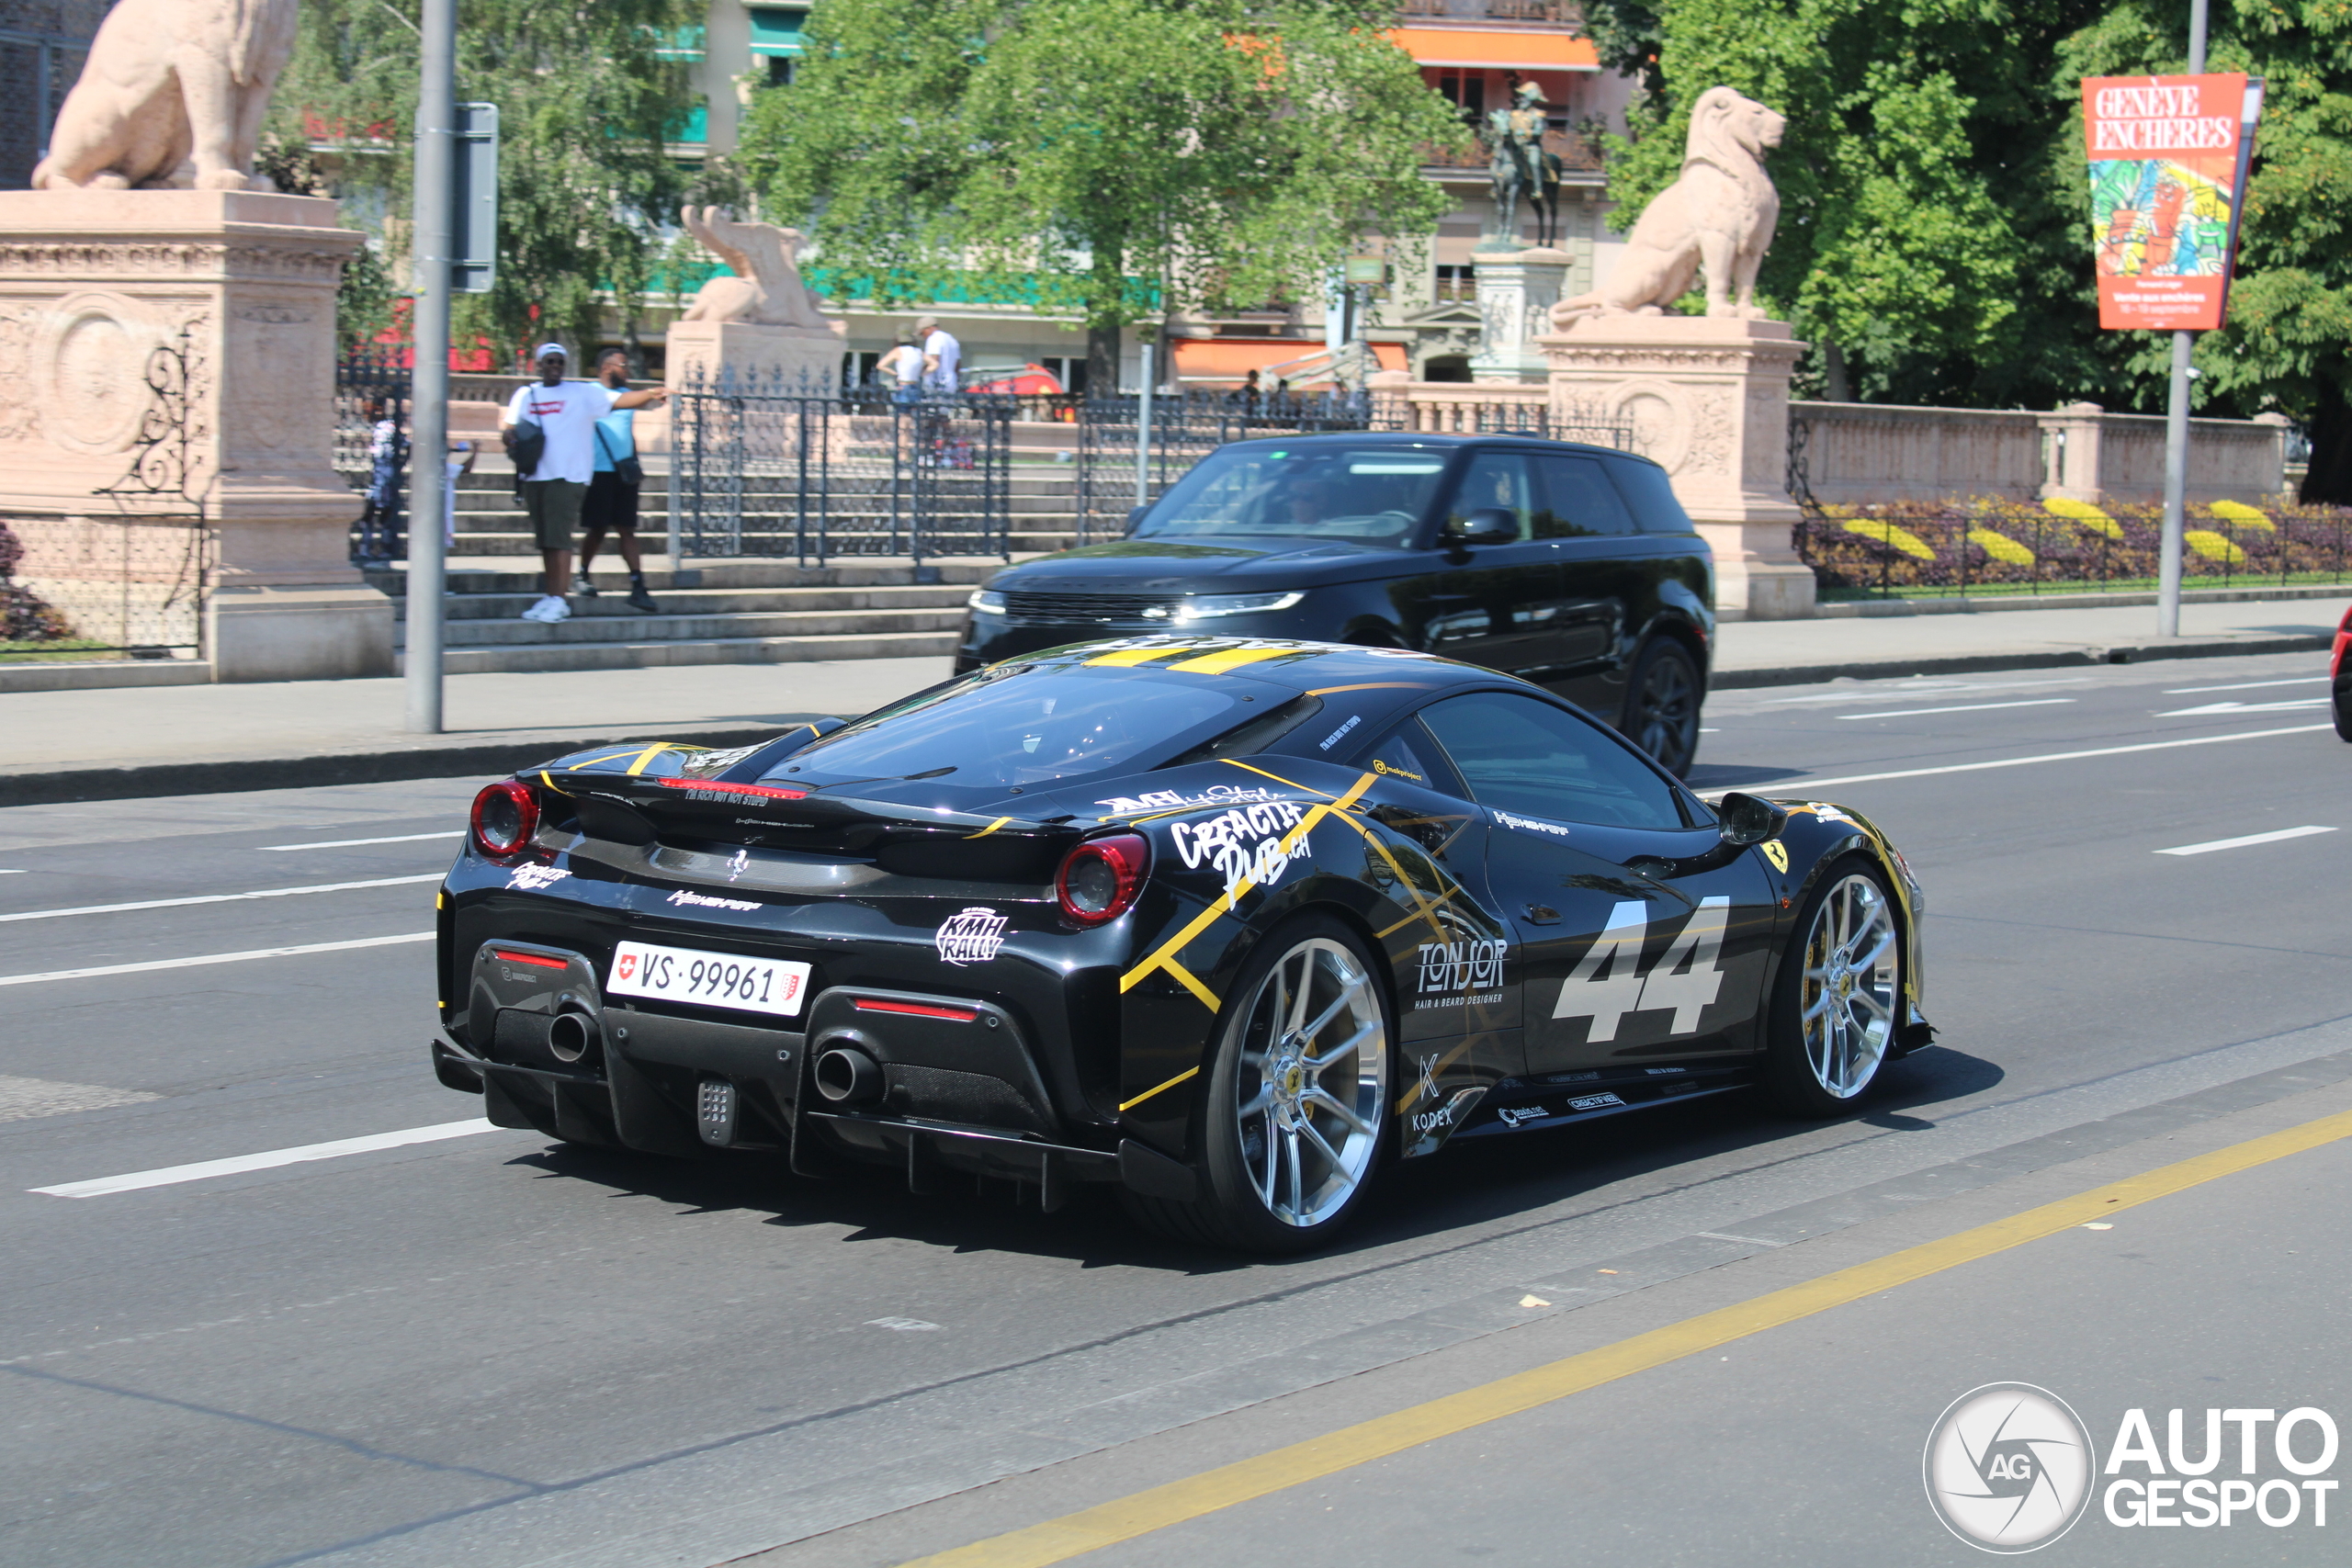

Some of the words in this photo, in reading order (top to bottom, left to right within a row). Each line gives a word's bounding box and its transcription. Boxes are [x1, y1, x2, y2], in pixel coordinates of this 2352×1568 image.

[2095, 77, 2199, 118] GENÈVE
[697, 790, 714, 801] RICH
[714, 792, 728, 803] BUT
[728, 793, 743, 805] NOT
[742, 795, 768, 807] STUPID
[941, 916, 1009, 936] KMH
[941, 936, 1004, 962] RALLY
[1552, 895, 1730, 1043] 44
[1415, 1000, 1431, 1010] HAIR
[1434, 998, 1439, 1008] &
[1442, 997, 1464, 1007] BEARD
[1467, 994, 1502, 1005] DESIGNER
[1412, 1110, 1453, 1131] KODEX
